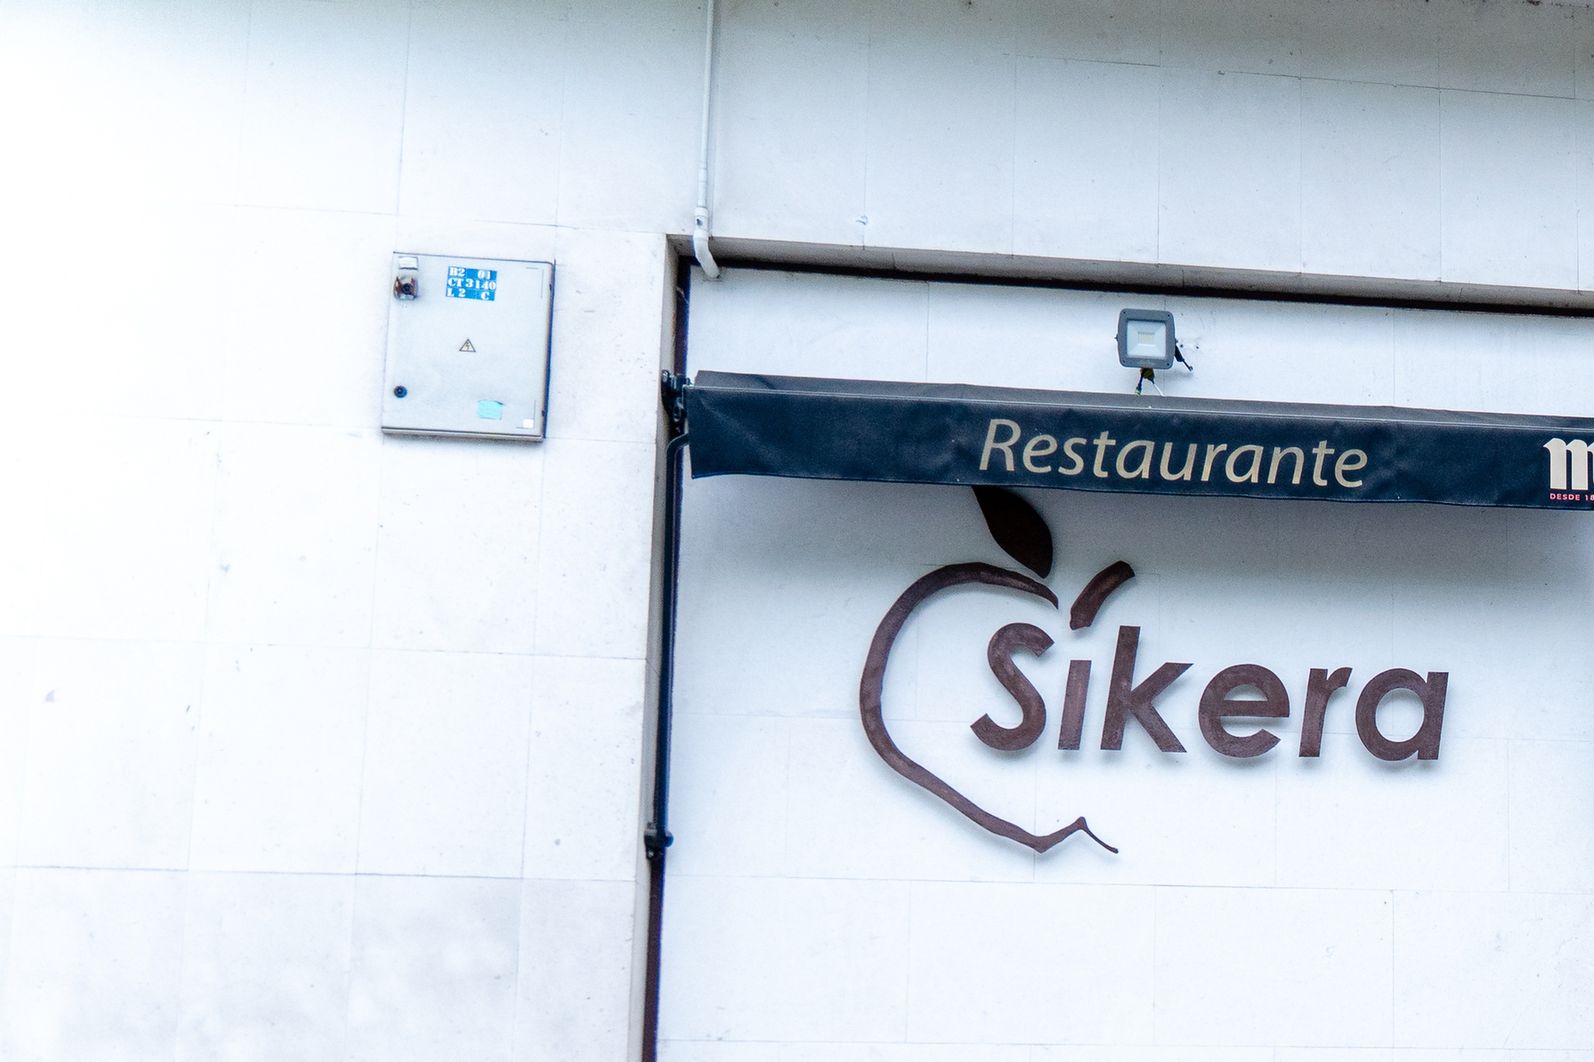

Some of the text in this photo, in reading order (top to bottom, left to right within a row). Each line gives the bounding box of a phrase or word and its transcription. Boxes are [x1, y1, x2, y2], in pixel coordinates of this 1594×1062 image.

[448, 277, 464, 287] CT
[449, 267, 465, 277] B2
[979, 418, 1368, 488] Restaurante
[970, 618, 1449, 762] Sikera
